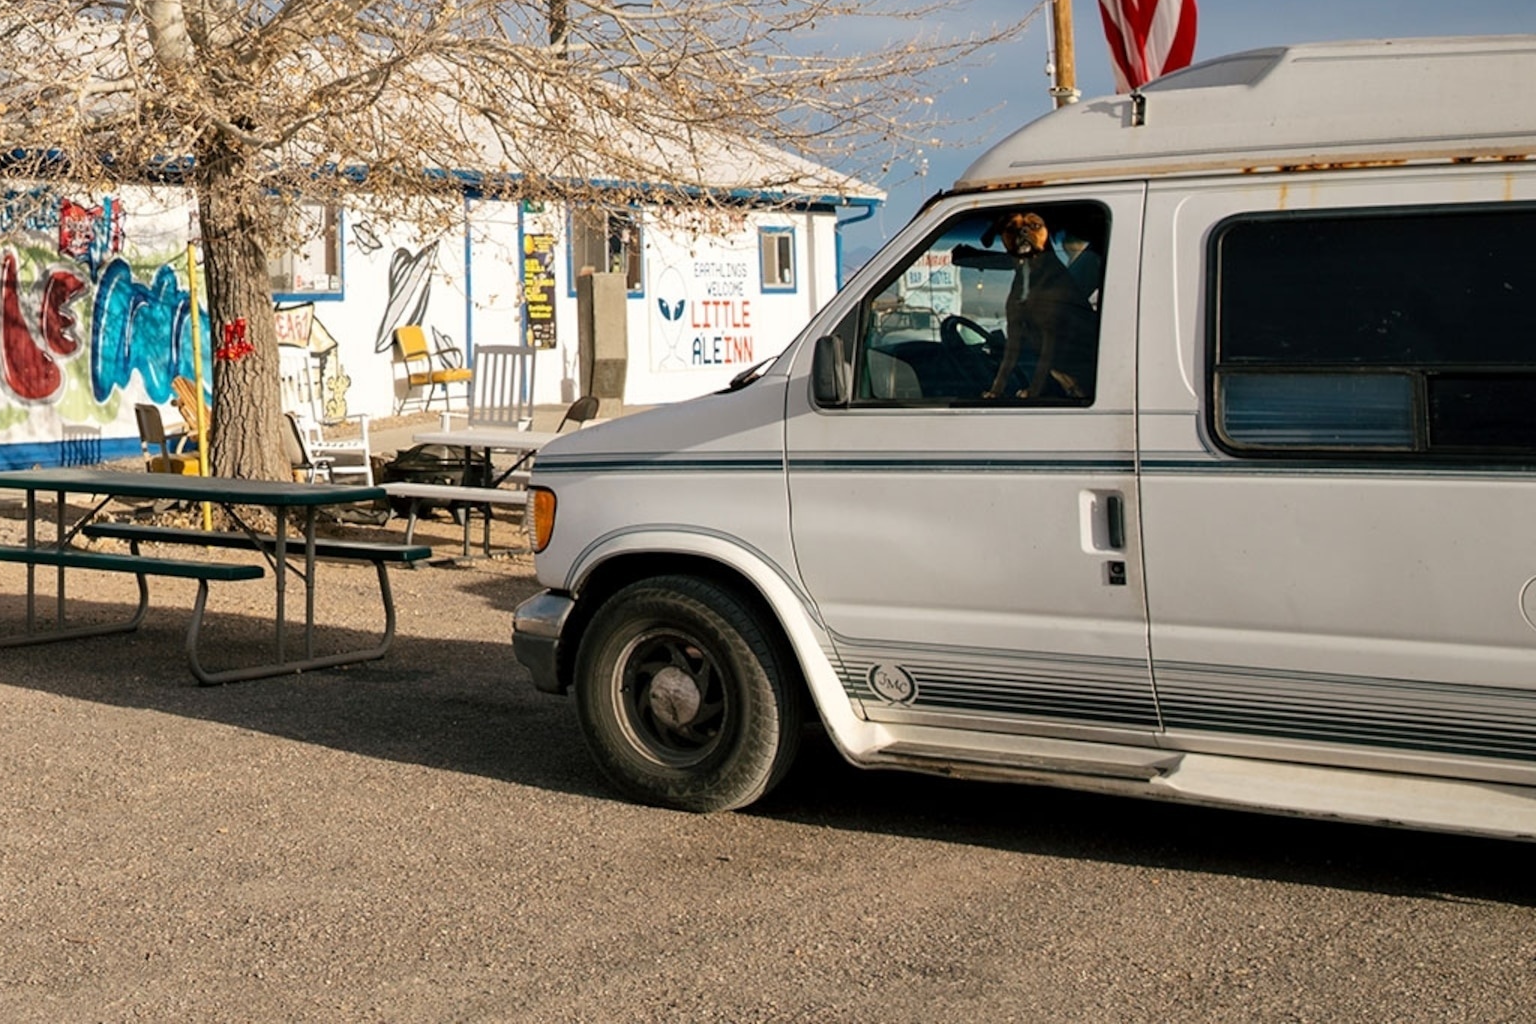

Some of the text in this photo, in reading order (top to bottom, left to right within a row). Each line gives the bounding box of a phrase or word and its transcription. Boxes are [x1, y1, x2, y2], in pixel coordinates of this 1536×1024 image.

[694, 261, 748, 278] EARTHLINGS
[706, 281, 745, 297] WELCOME
[690, 300, 751, 329] LITTLE
